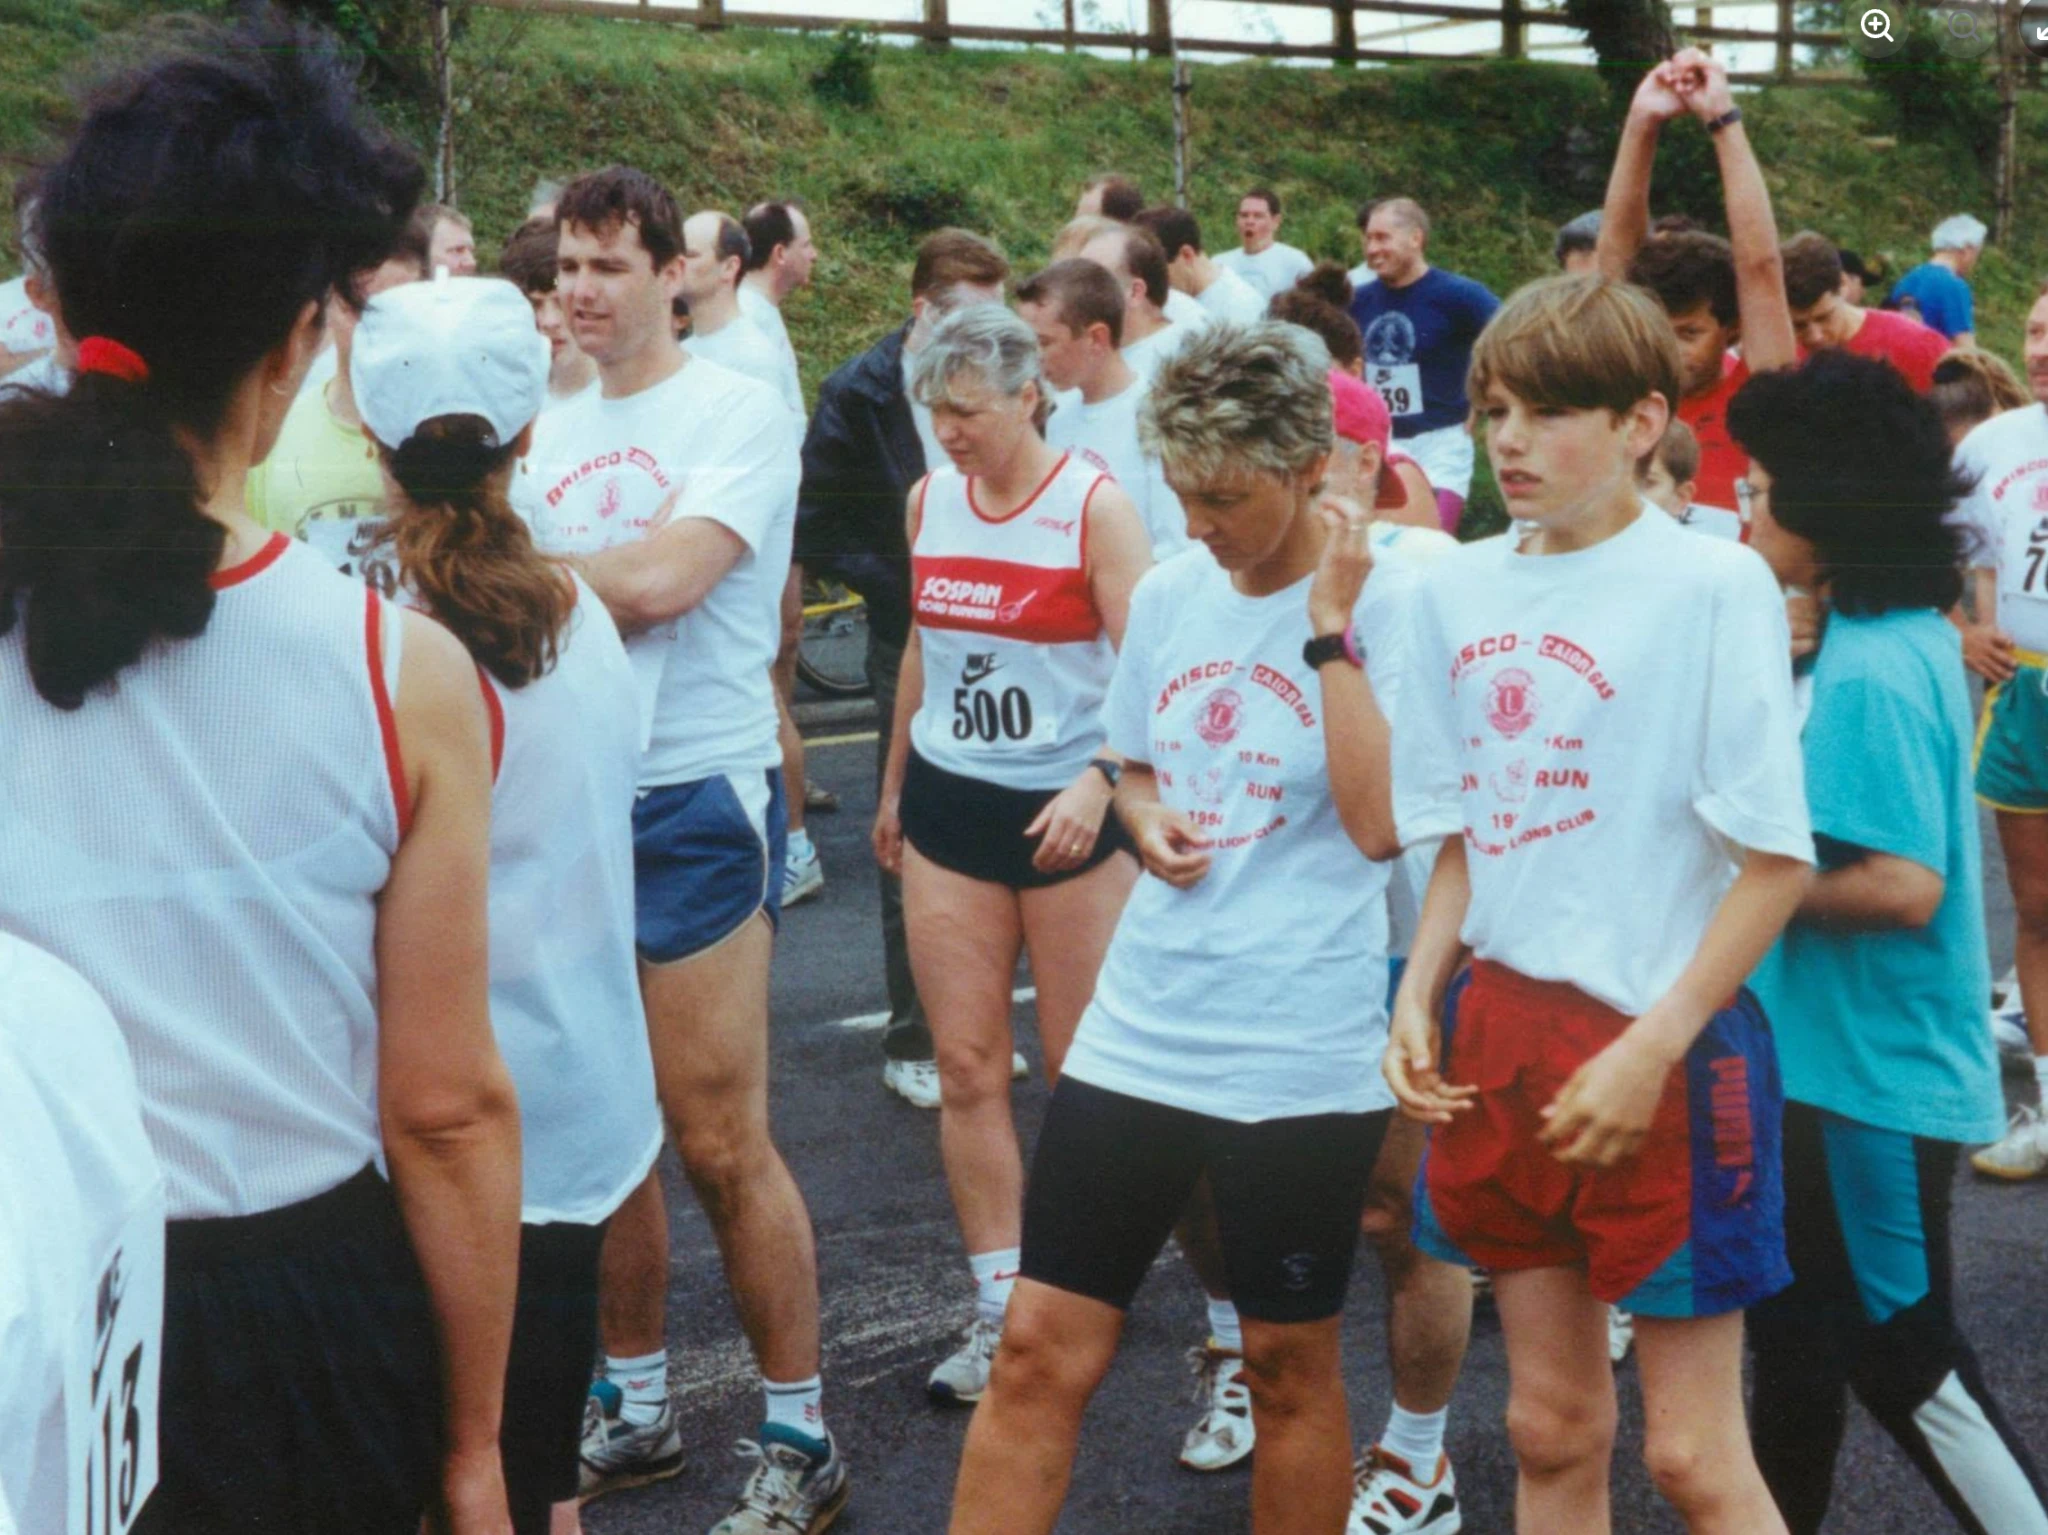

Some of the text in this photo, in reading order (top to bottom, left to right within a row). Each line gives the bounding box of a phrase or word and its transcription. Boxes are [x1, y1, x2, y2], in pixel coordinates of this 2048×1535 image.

[1378, 387, 1410, 413] 39
[920, 577, 1002, 606] SOSPAN
[1587, 671, 1616, 701] GAS
[952, 686, 1032, 742] 500
[1552, 734, 1583, 750] Km
[1256, 752, 1281, 767] Km
[1246, 781, 1284, 801] RUN
[1535, 768, 1590, 790] RUN
[1509, 824, 1552, 849] LIONS
[1556, 808, 1596, 833] CLUB
